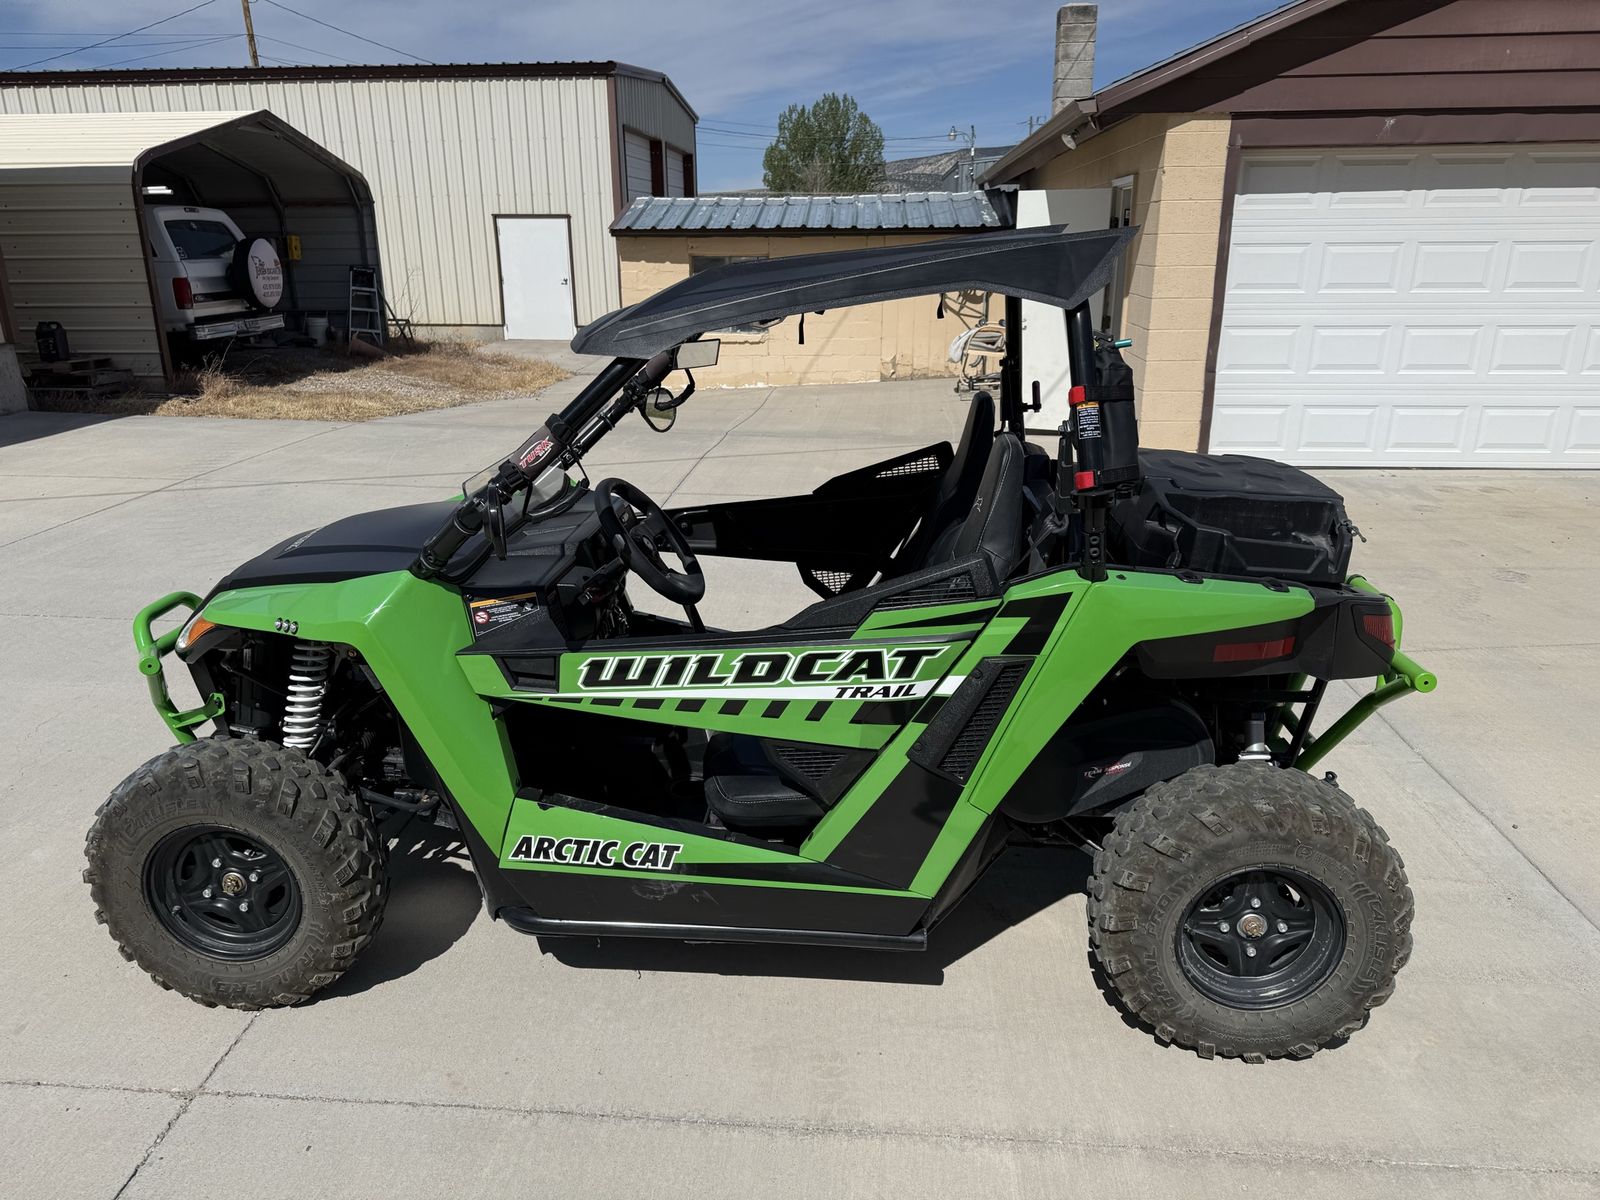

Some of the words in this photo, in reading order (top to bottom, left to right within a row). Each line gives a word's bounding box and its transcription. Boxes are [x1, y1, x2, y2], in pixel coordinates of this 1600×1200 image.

[577, 645, 951, 690] WILDCAT
[834, 683, 918, 699] TRAIL
[508, 834, 620, 867] ARCTIC
[622, 841, 684, 871] CAT
